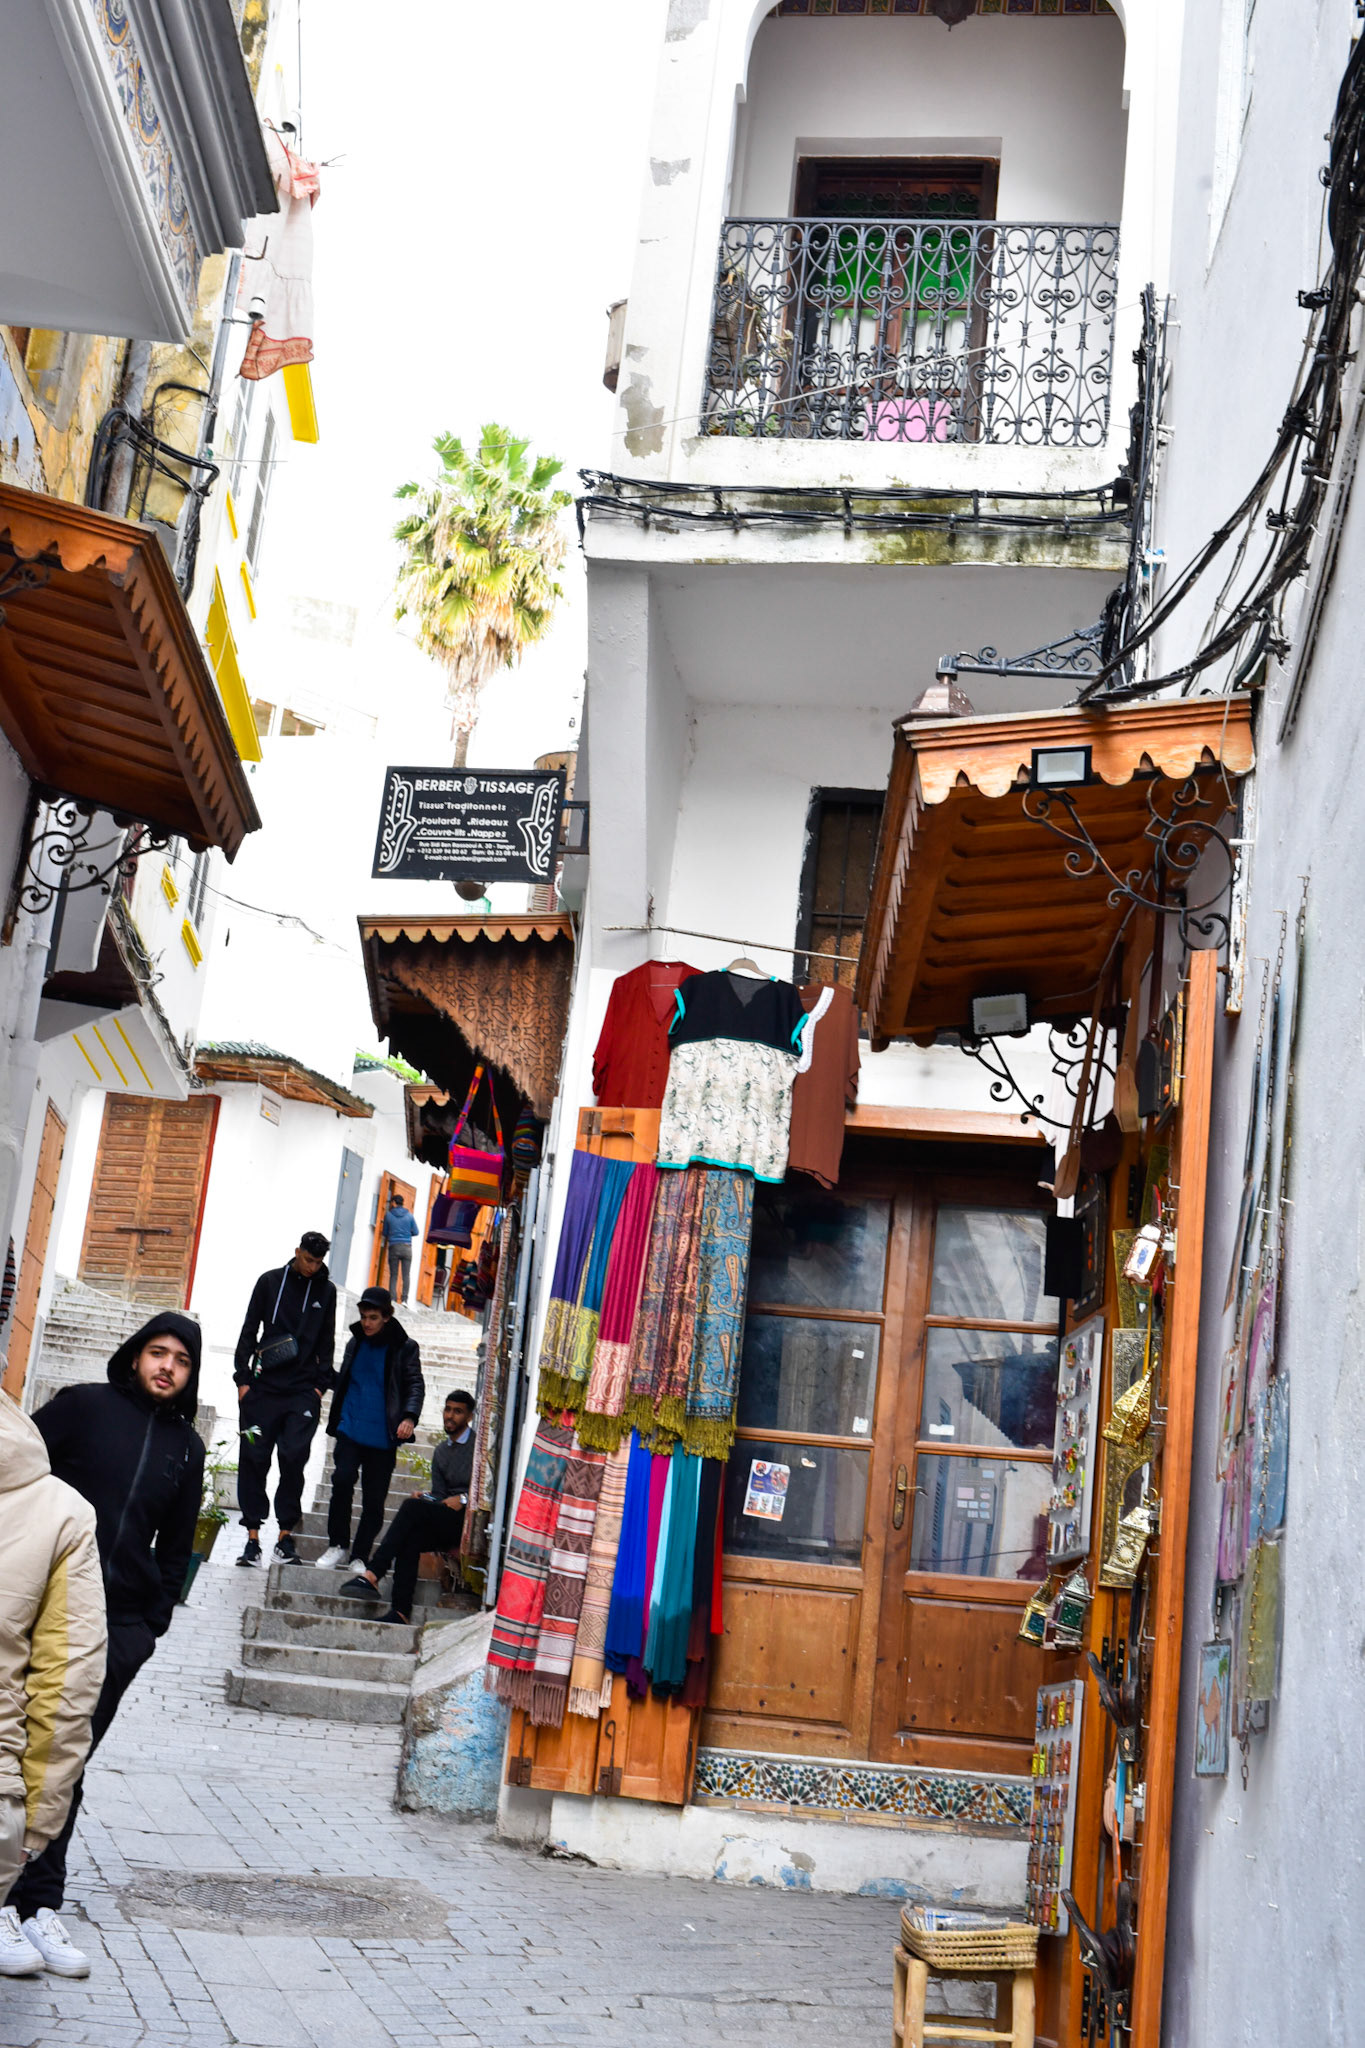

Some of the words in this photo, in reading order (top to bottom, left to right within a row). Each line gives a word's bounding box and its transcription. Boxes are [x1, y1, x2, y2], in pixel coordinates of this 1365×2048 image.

[414, 779, 462, 792] BERBER
[479, 781, 535, 794] TISSAGE
[418, 802, 445, 810] Tissus
